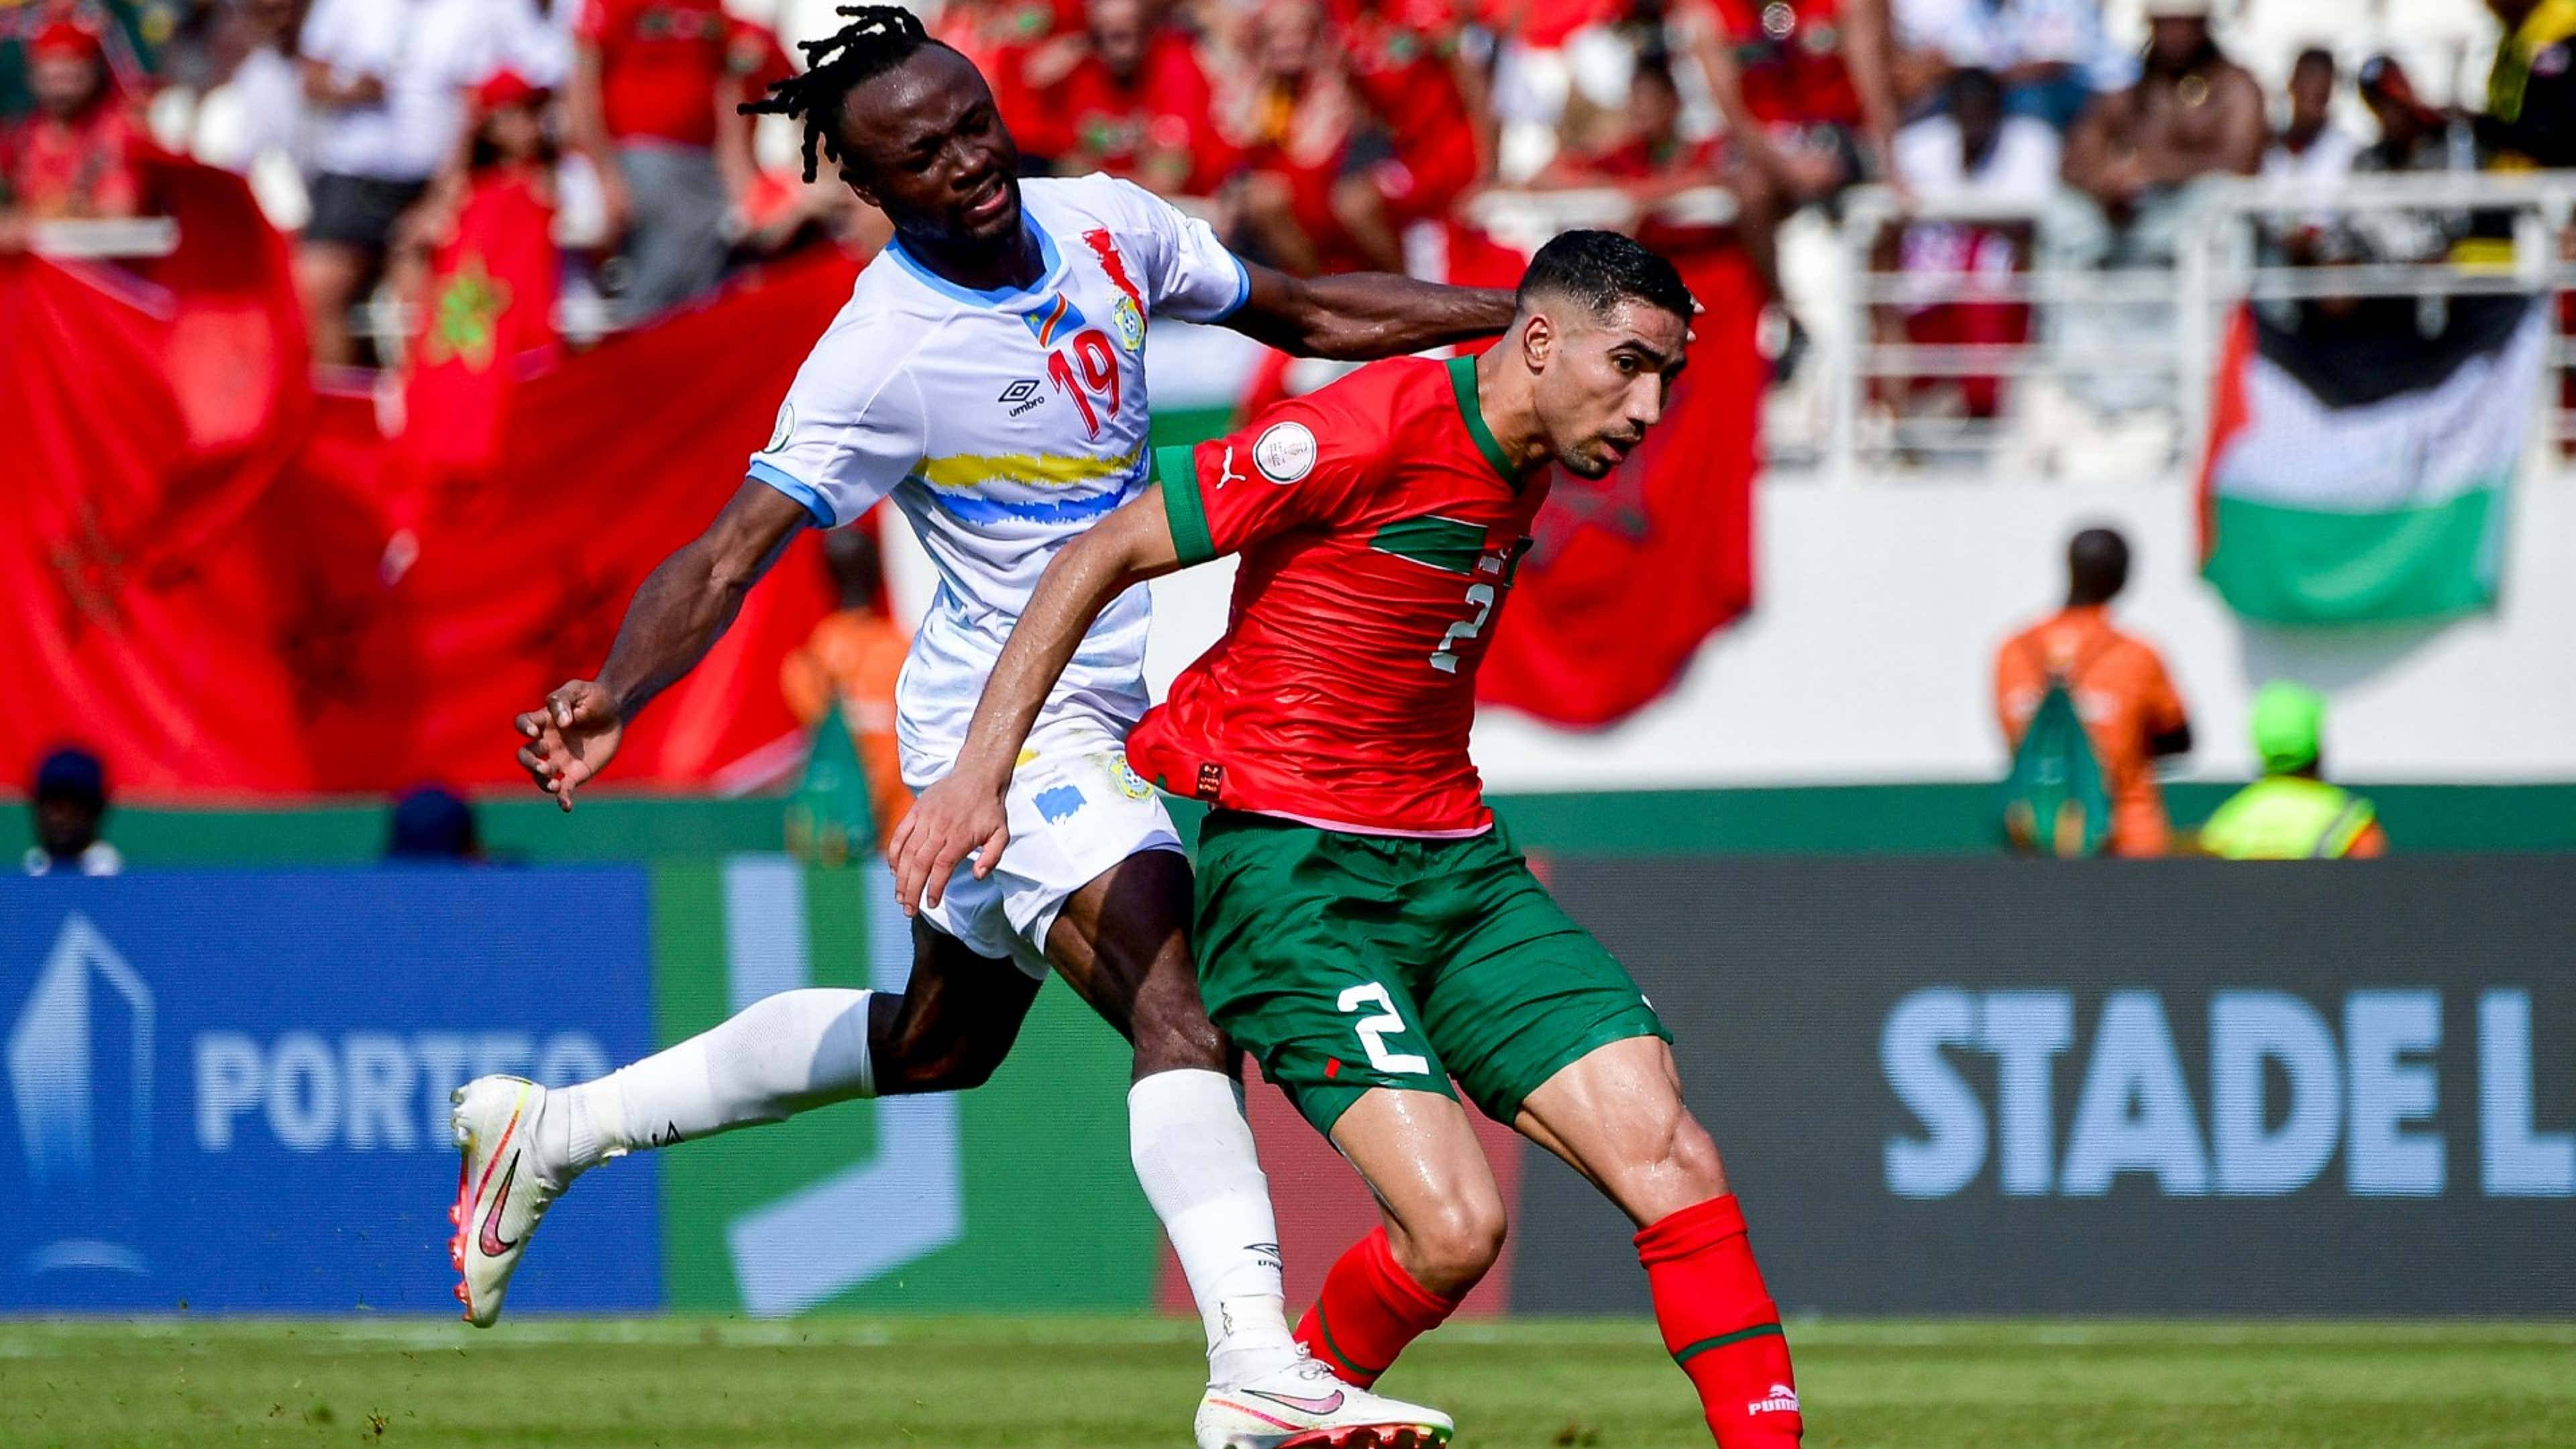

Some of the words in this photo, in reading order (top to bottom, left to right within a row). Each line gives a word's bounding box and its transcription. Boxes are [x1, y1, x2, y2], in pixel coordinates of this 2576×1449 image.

[1008, 396, 1044, 417] umbro
[1046, 328, 1120, 441] 19
[1429, 583, 1495, 674] 2
[1336, 981, 1430, 1076] 2
[1881, 986, 2447, 1199] STADE
[2477, 986, 2576, 1198] L
